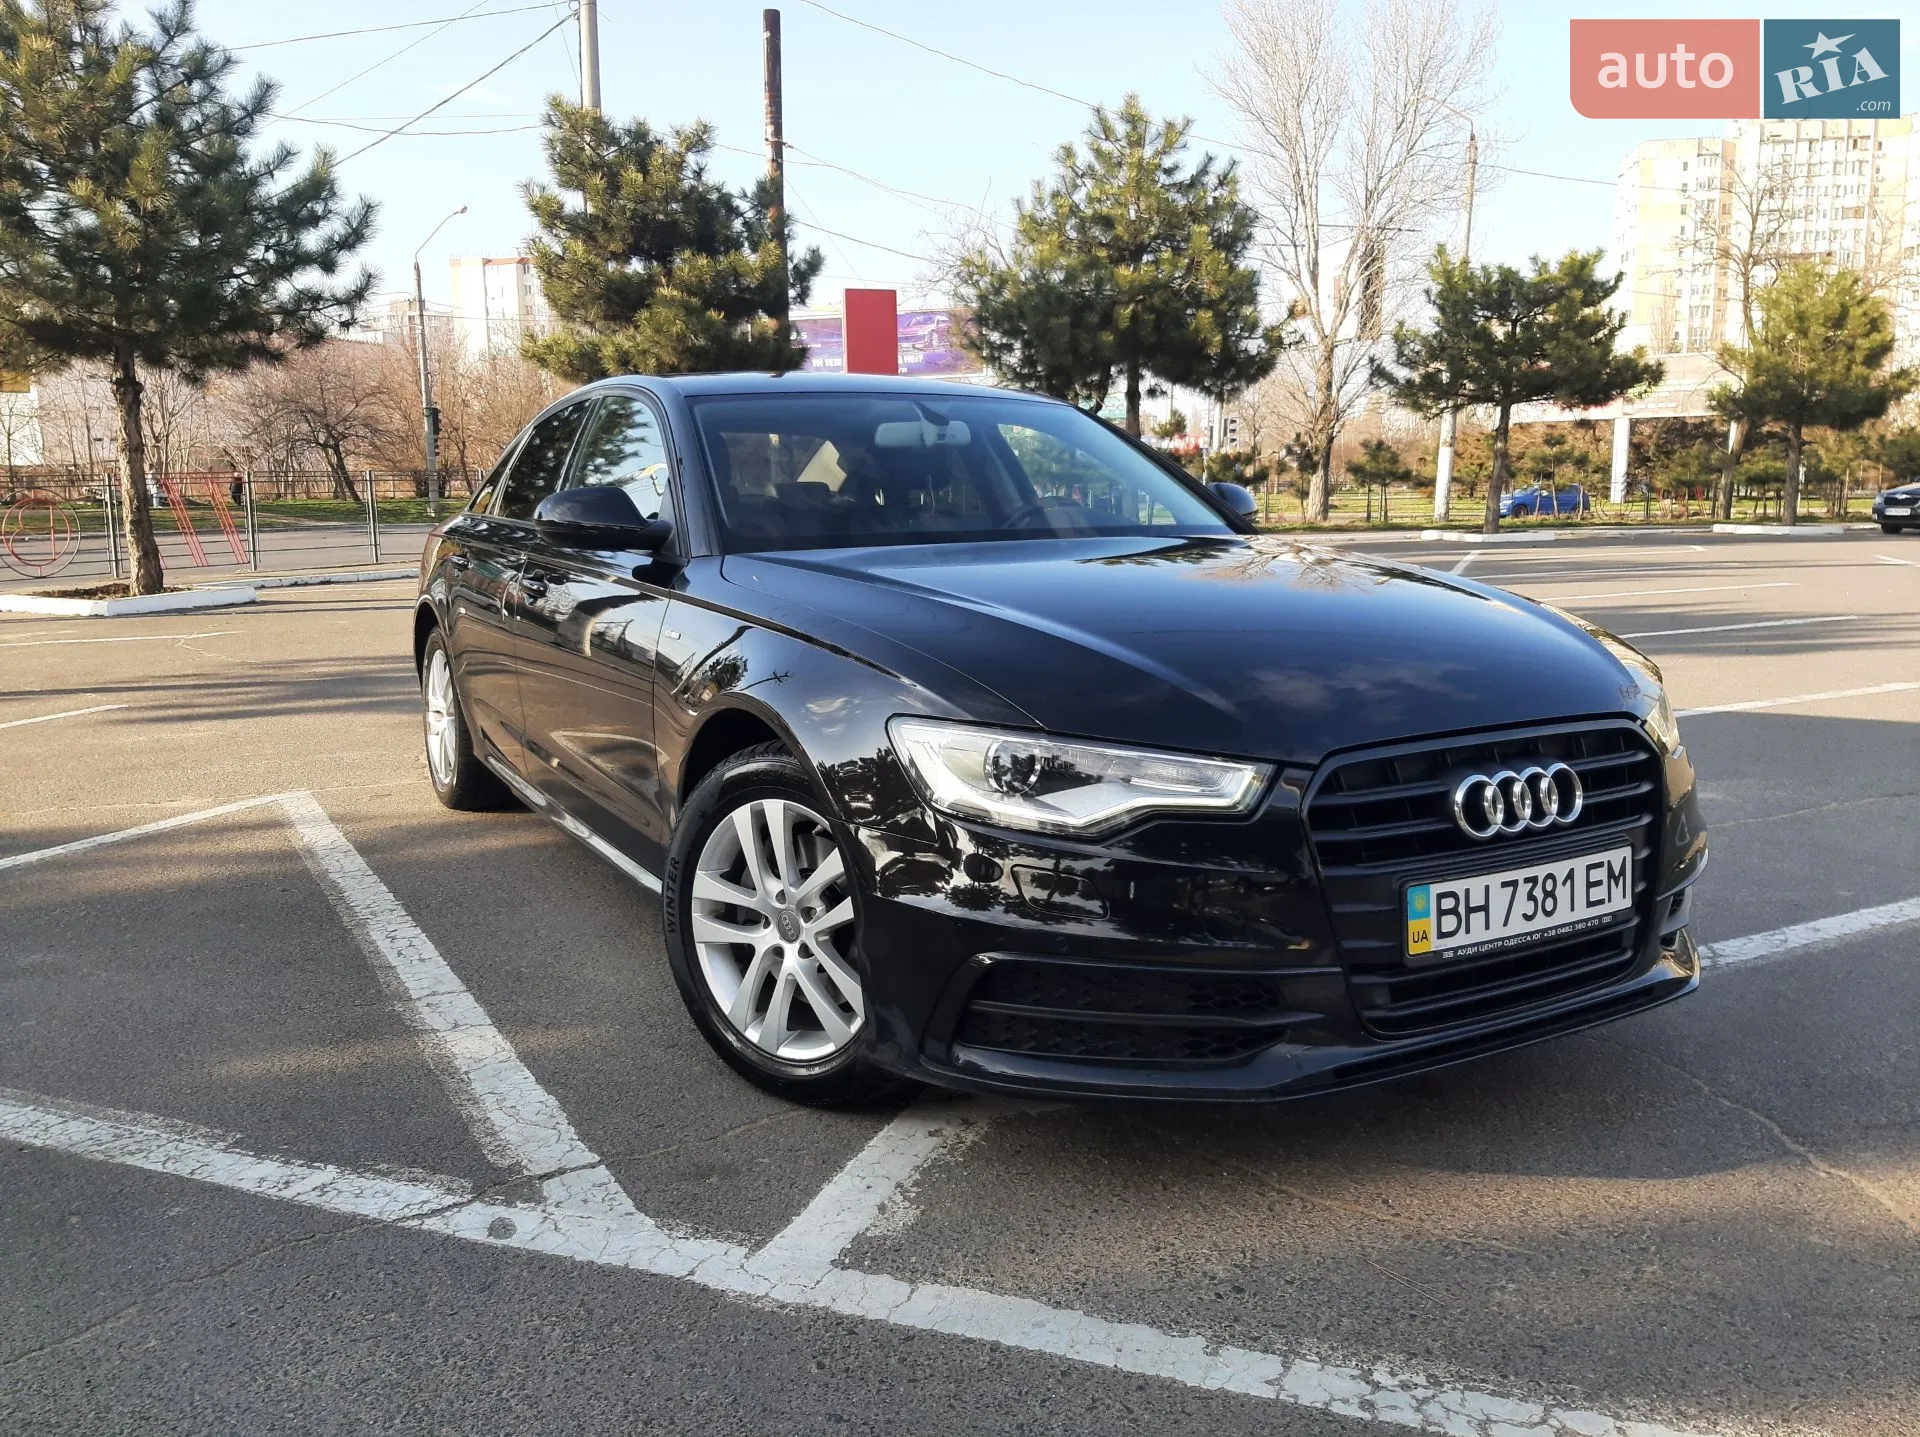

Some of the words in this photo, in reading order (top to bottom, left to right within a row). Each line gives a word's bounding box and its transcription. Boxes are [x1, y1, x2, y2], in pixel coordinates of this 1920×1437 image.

[664, 856, 680, 934] WINTER
[1436, 884, 1490, 940] BH
[1501, 867, 1575, 927] 7381
[1586, 856, 1627, 909] EM
[1412, 929, 1429, 943] UA
[1457, 946, 1478, 956] АУДИ
[1479, 941, 1503, 953] ЦЕНТР
[1504, 935, 1532, 947] ОДЕССА
[1533, 932, 1542, 941] ЮГ
[1544, 929, 1556, 937] +38
